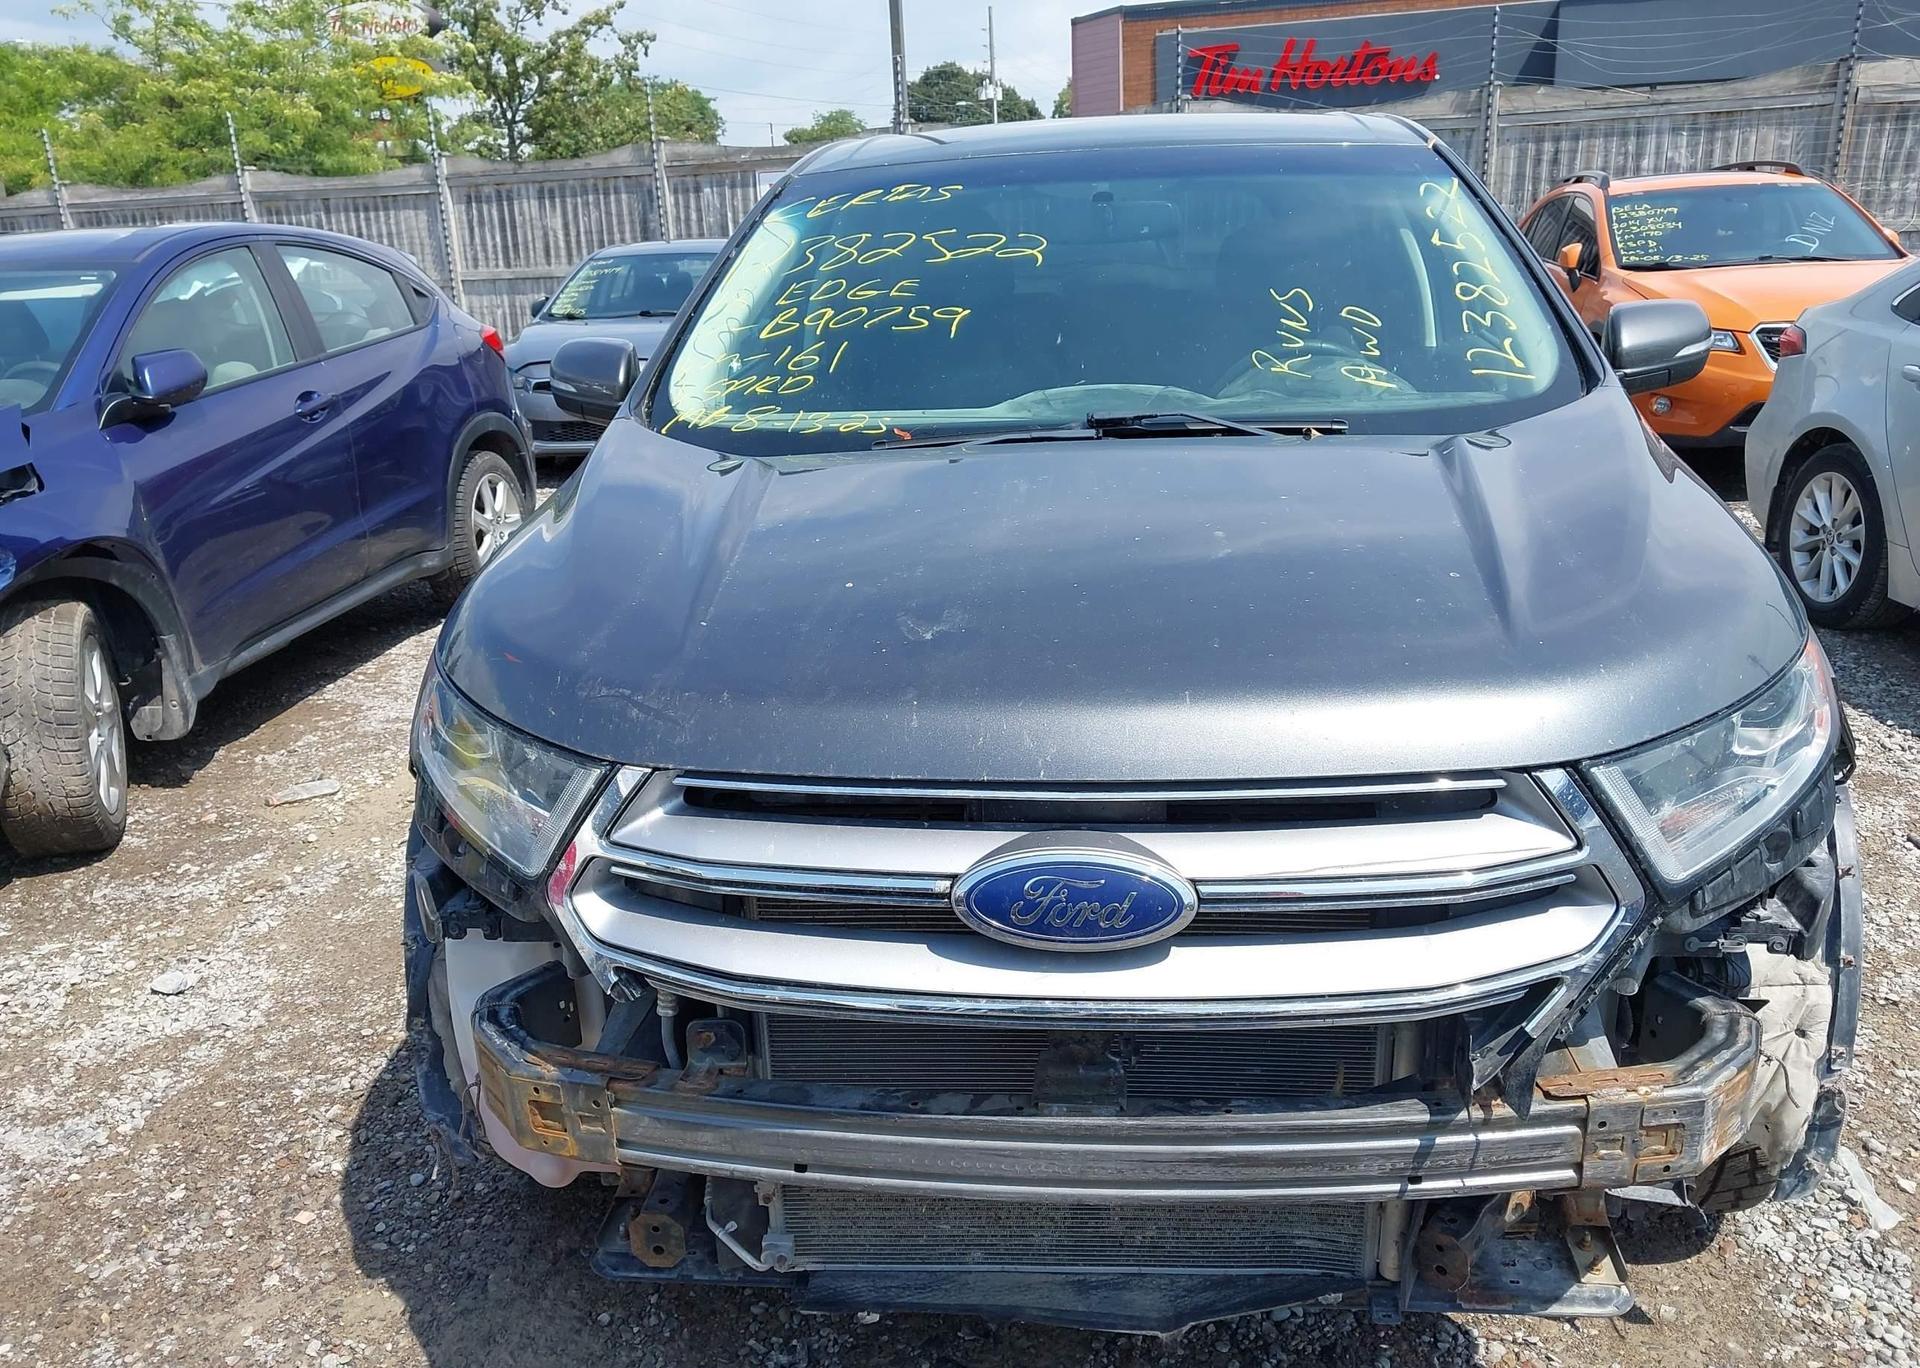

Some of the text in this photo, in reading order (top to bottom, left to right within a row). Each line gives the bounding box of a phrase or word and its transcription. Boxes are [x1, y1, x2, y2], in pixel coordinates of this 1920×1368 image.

[1188, 37, 1439, 97] Tim Hortons
[1784, 210, 1836, 255] DNZ
[776, 279, 921, 305] EDGE
[1418, 177, 1537, 379] 12382522
[1339, 305, 1397, 388] AWD
[1010, 875, 1138, 929] Ford
